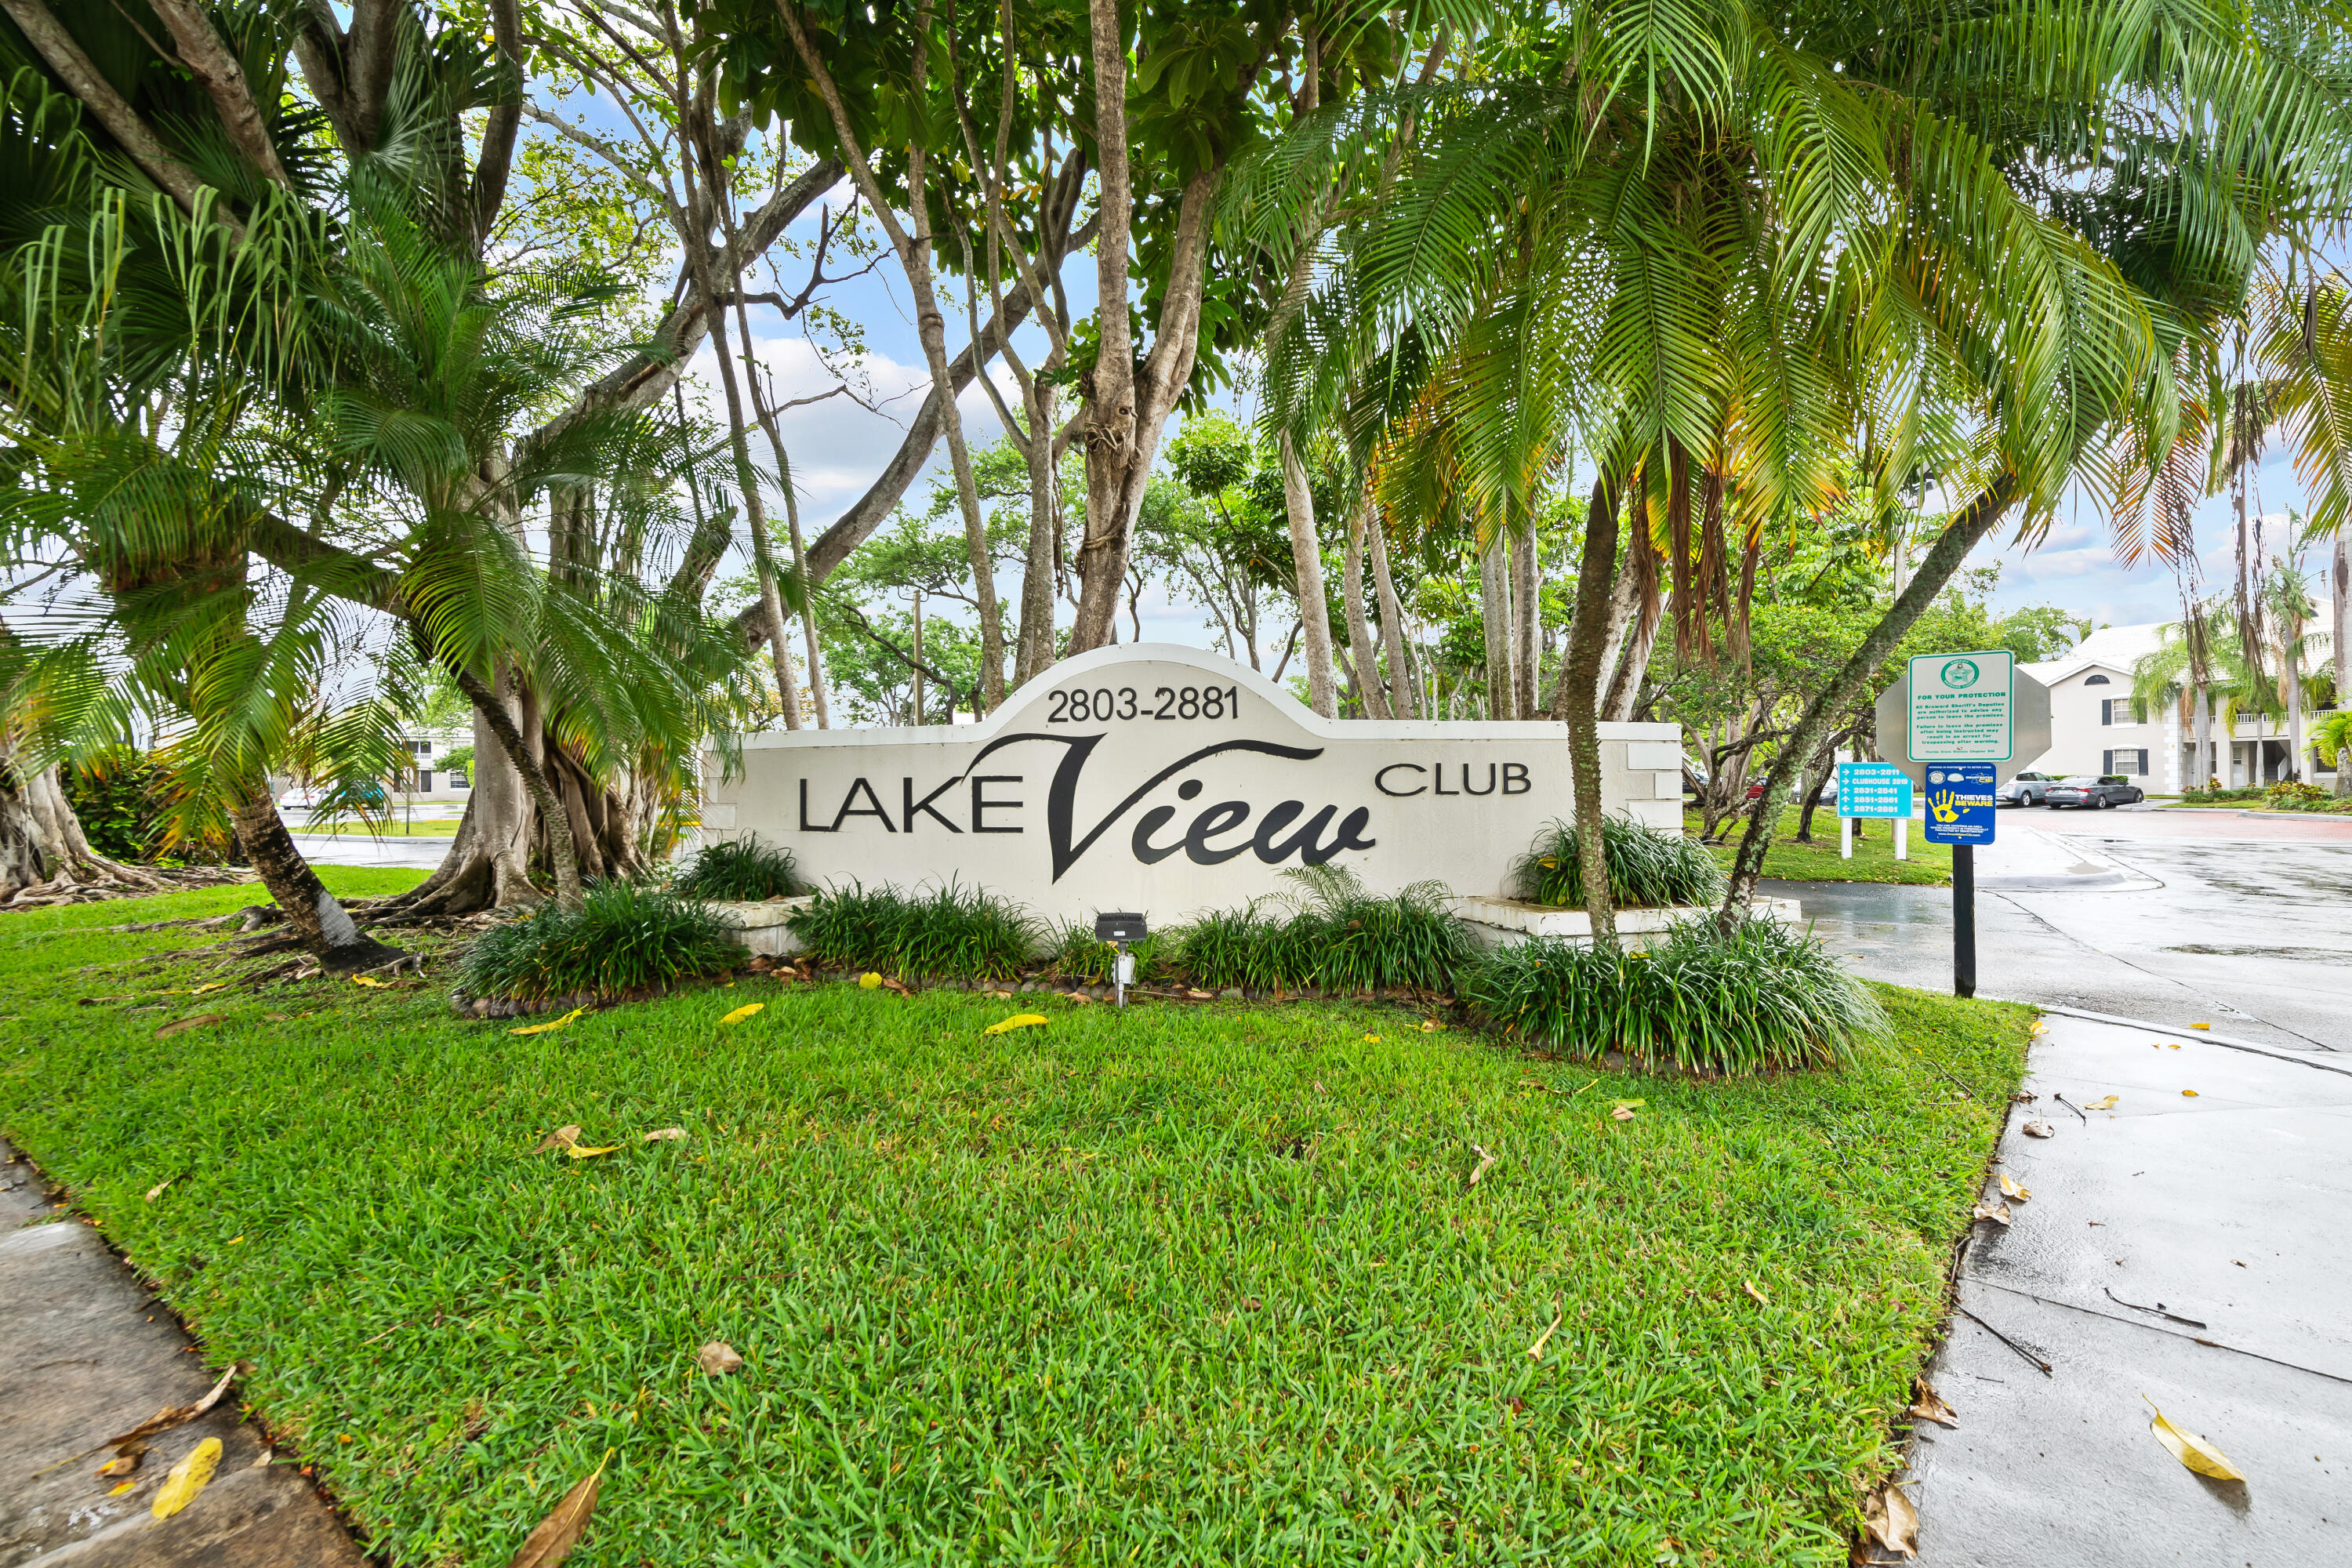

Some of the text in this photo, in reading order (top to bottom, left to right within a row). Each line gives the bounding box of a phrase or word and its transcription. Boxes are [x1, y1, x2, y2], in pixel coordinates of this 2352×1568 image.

[1047, 686, 1239, 723] 2803-2881
[798, 731, 1532, 884] LAKE View CLUB
